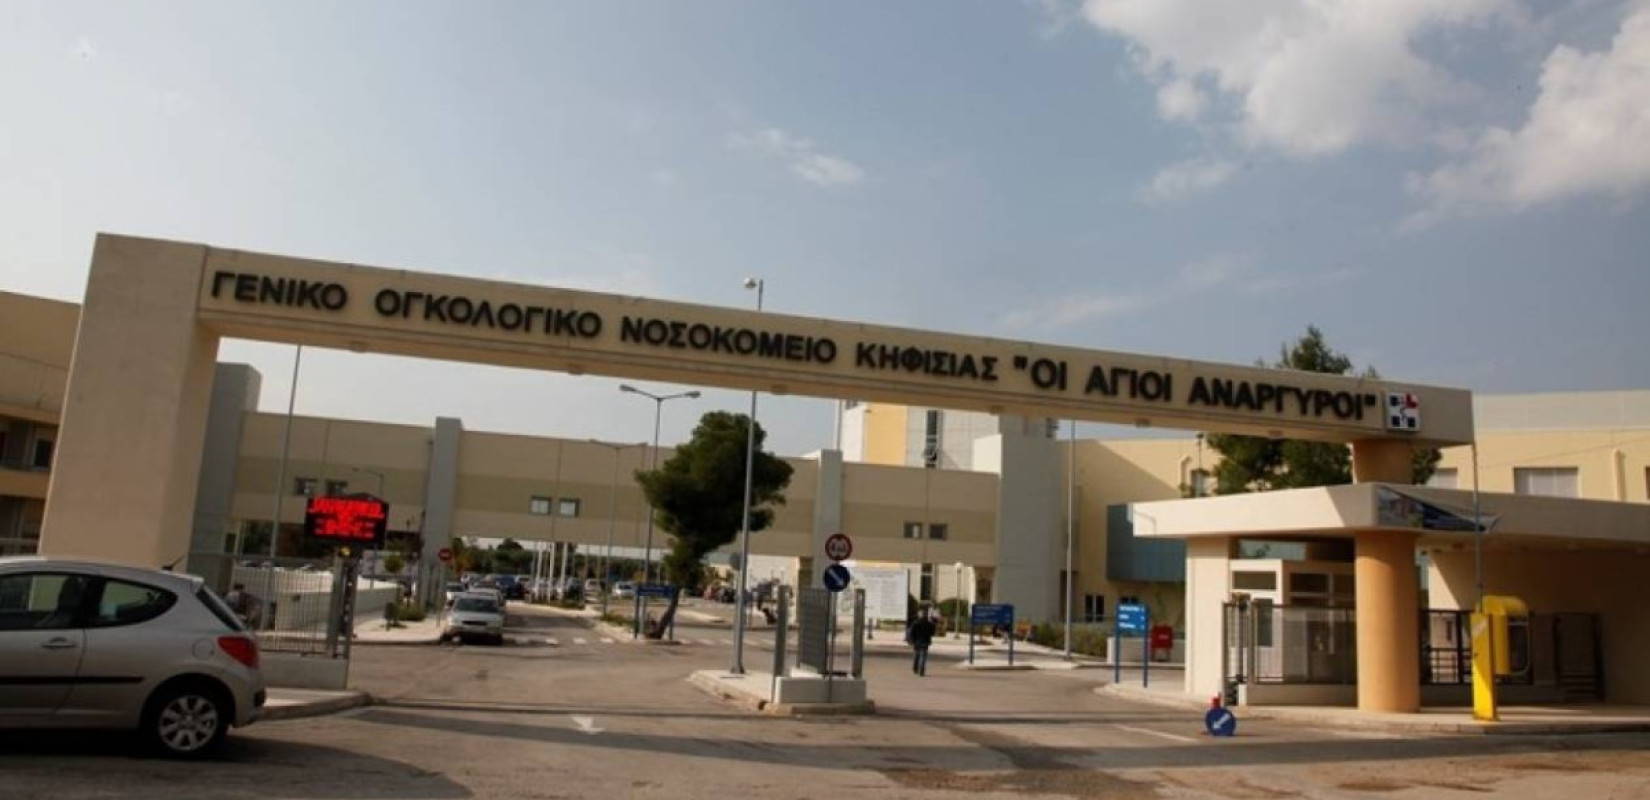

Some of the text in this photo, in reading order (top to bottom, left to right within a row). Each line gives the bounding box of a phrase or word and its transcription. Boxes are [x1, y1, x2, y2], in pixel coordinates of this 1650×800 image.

[211, 270, 1377, 420] ΓΕΝΙΚΟ ΟΓΚΟΛΟΓΙΚΟ ΝΟΣΟΚΟΜΕΙΟ ΚΗΦΙΣΙΑΣ "ΟΙ ΑΓΙΟΙ ΑΝΑΡΓΥΡΟΙ"
